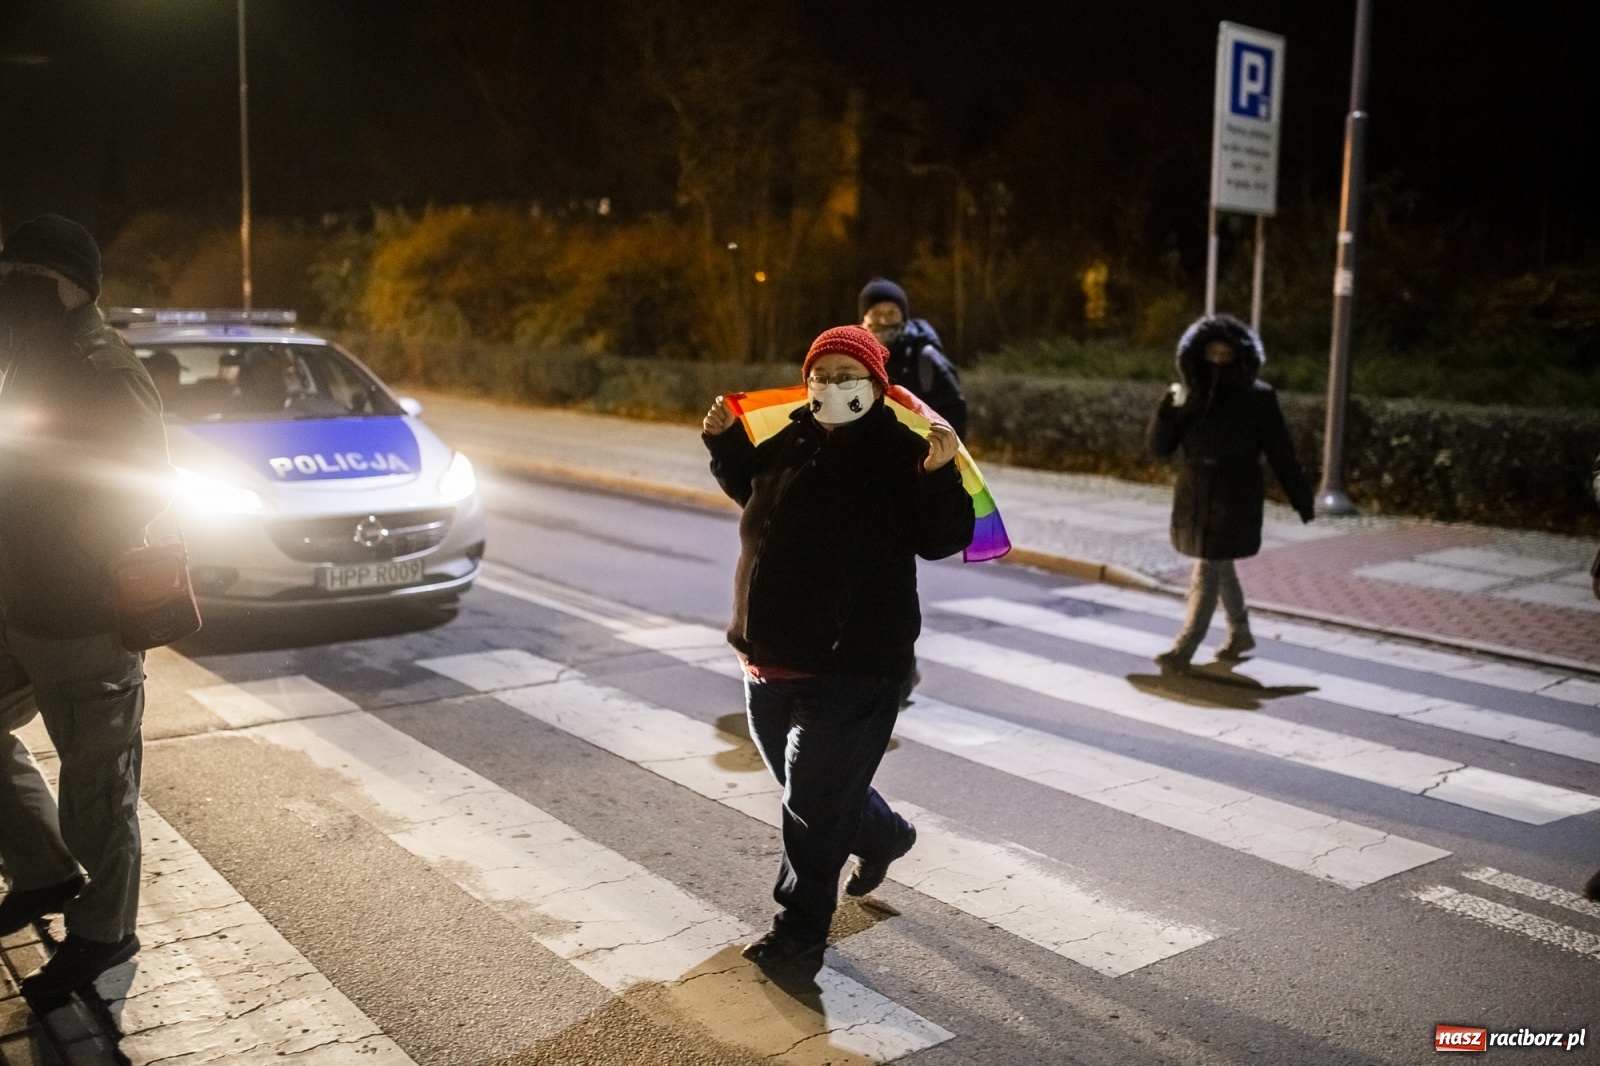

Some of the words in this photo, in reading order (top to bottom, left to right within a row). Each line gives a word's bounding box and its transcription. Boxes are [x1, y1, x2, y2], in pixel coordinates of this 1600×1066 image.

[1240, 50, 1266, 108] P
[269, 452, 411, 478] POLICJA
[329, 567, 370, 587] HPP
[376, 560, 419, 583] R009
